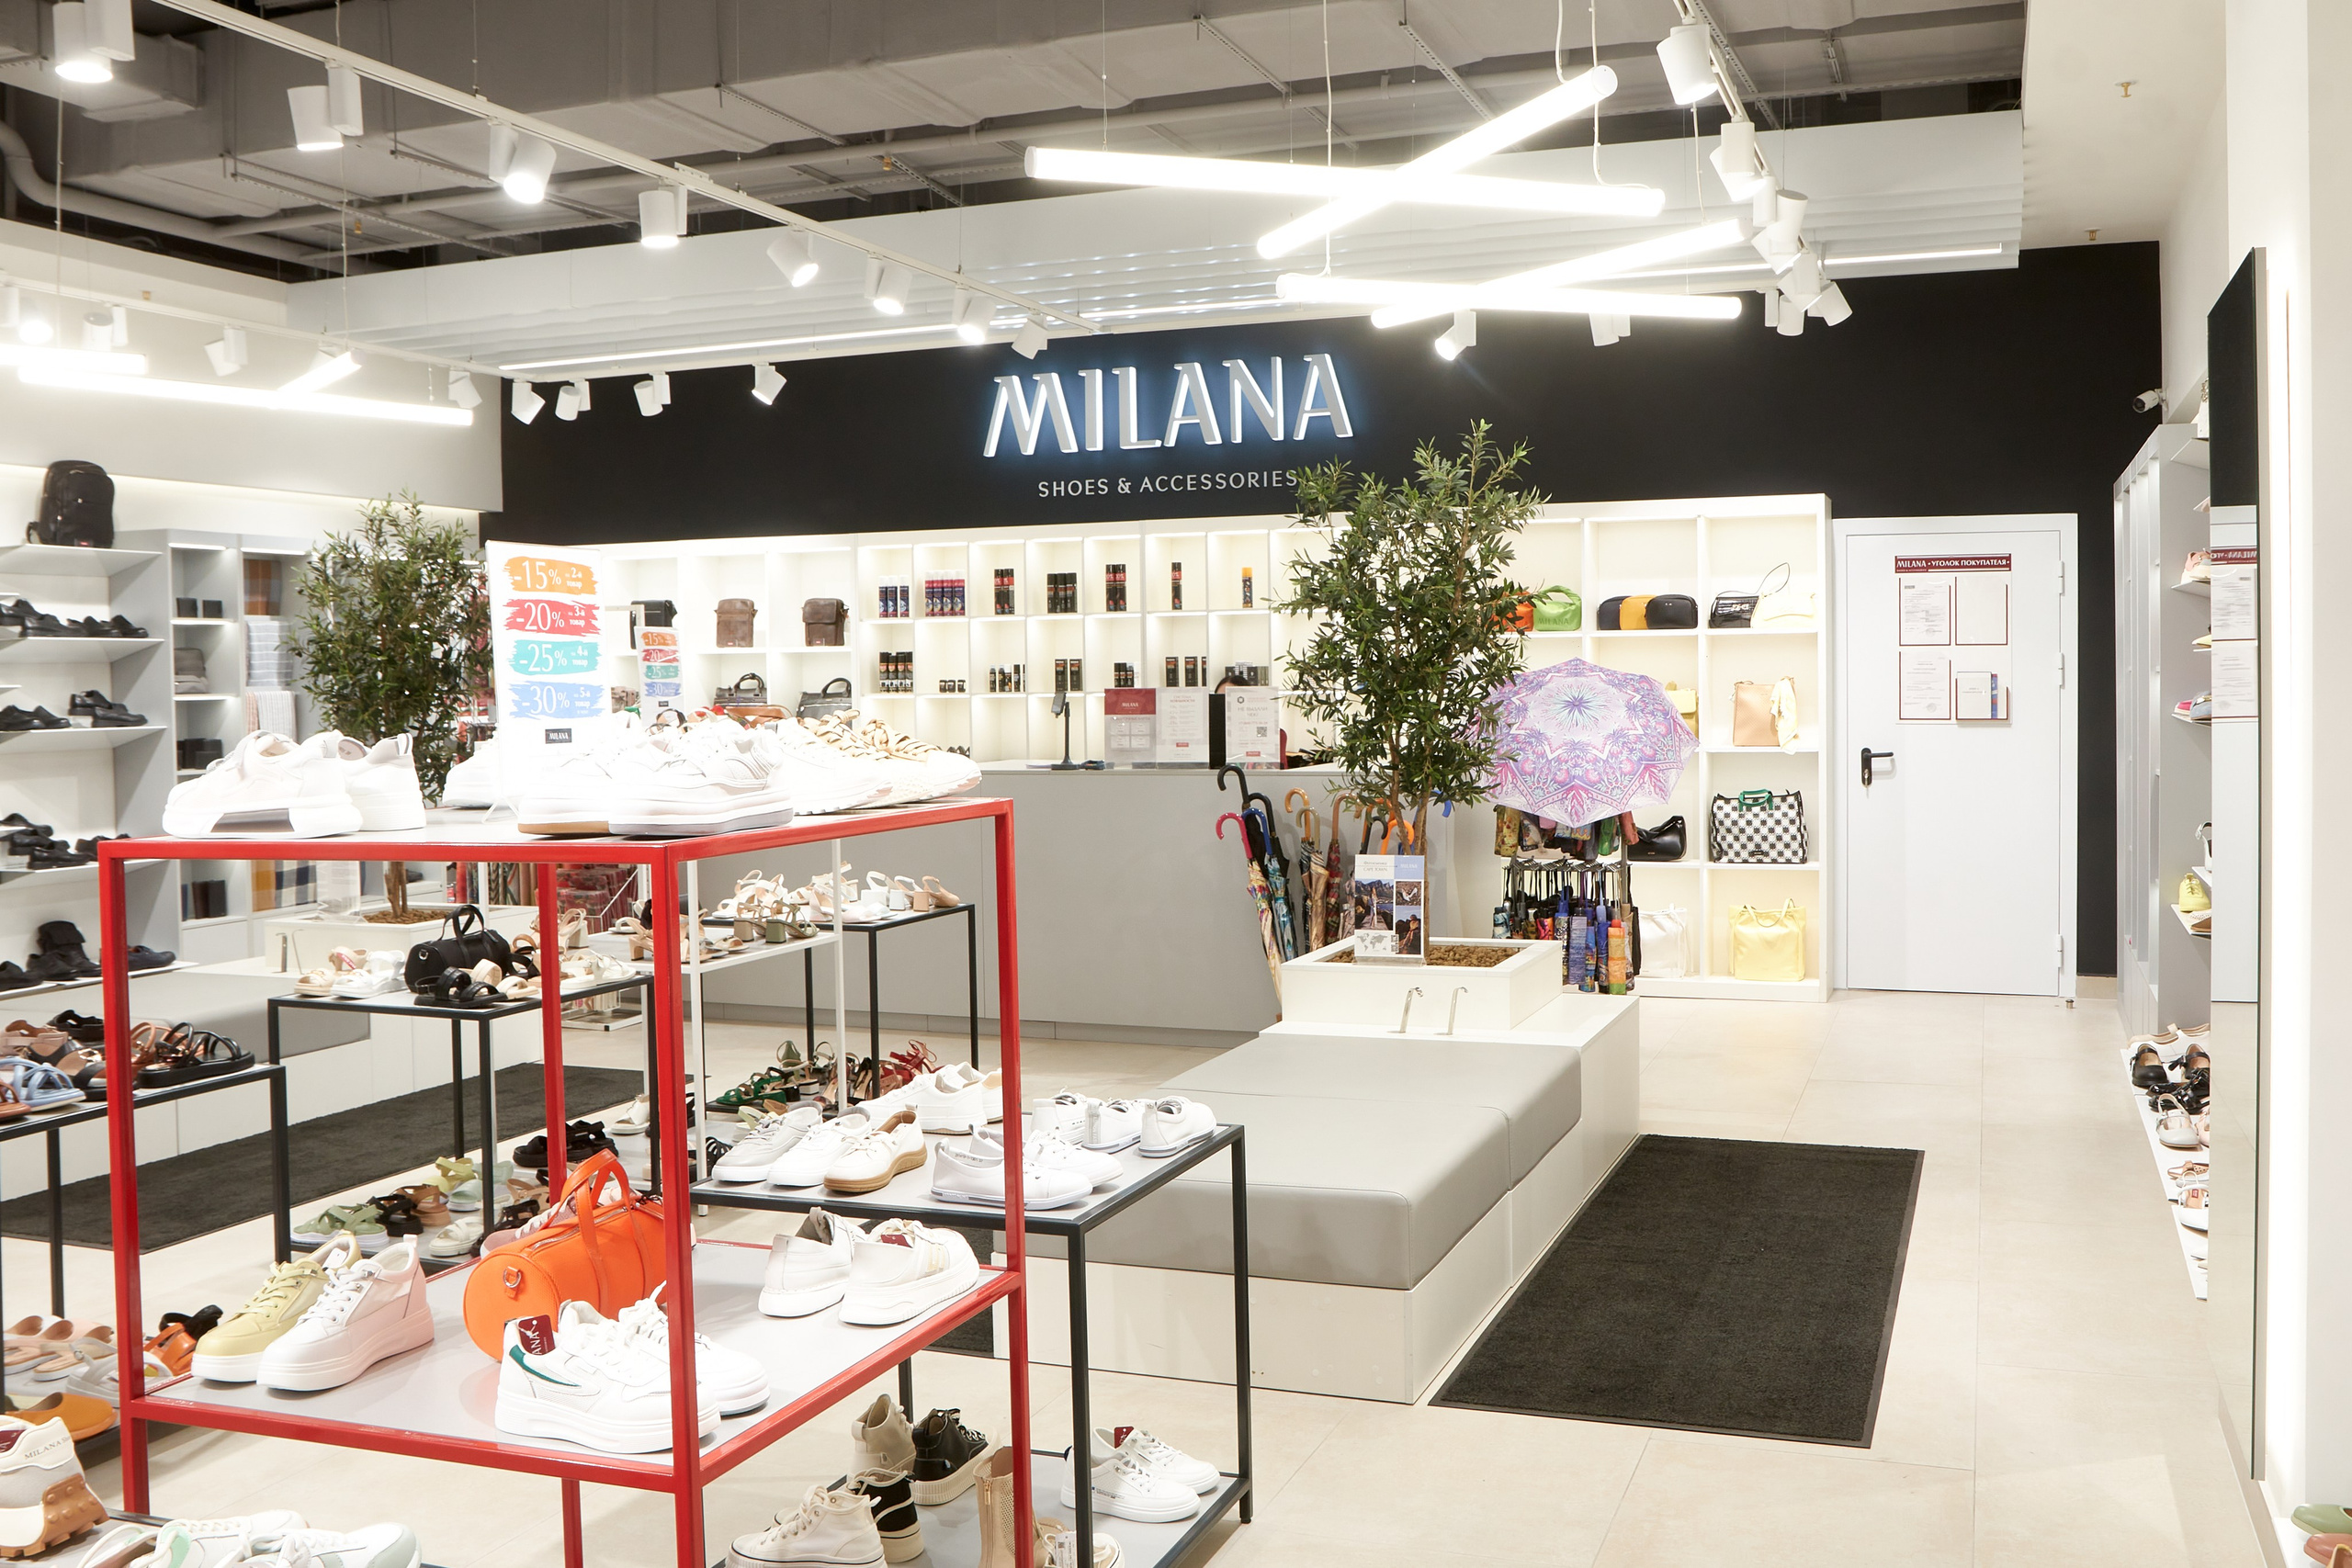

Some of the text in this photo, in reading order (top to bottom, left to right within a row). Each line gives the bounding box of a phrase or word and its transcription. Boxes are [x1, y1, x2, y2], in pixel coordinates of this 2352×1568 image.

[983, 353, 1354, 457] MILANA
[1037, 469, 1298, 498] SHOES & ACCESSORIES
[1961, 558, 2007, 567] ПОКУПАТЕЛЯ
[514, 560, 561, 590] -15%
[571, 567, 582, 579] 2-й
[566, 580, 582, 589] товар
[515, 602, 565, 631] -20%
[574, 605, 585, 616] 3-й
[569, 618, 585, 628] товар
[1537, 617, 1569, 626] MILANA
[519, 643, 568, 672] -25%
[576, 645, 588, 657] 4-й
[571, 659, 588, 668] товар
[522, 685, 571, 715] -30%
[580, 686, 591, 698] 5-й
[574, 700, 591, 709] товар
[548, 732, 569, 740] MILANA
[24, 1440, 62, 1460] MILANA
